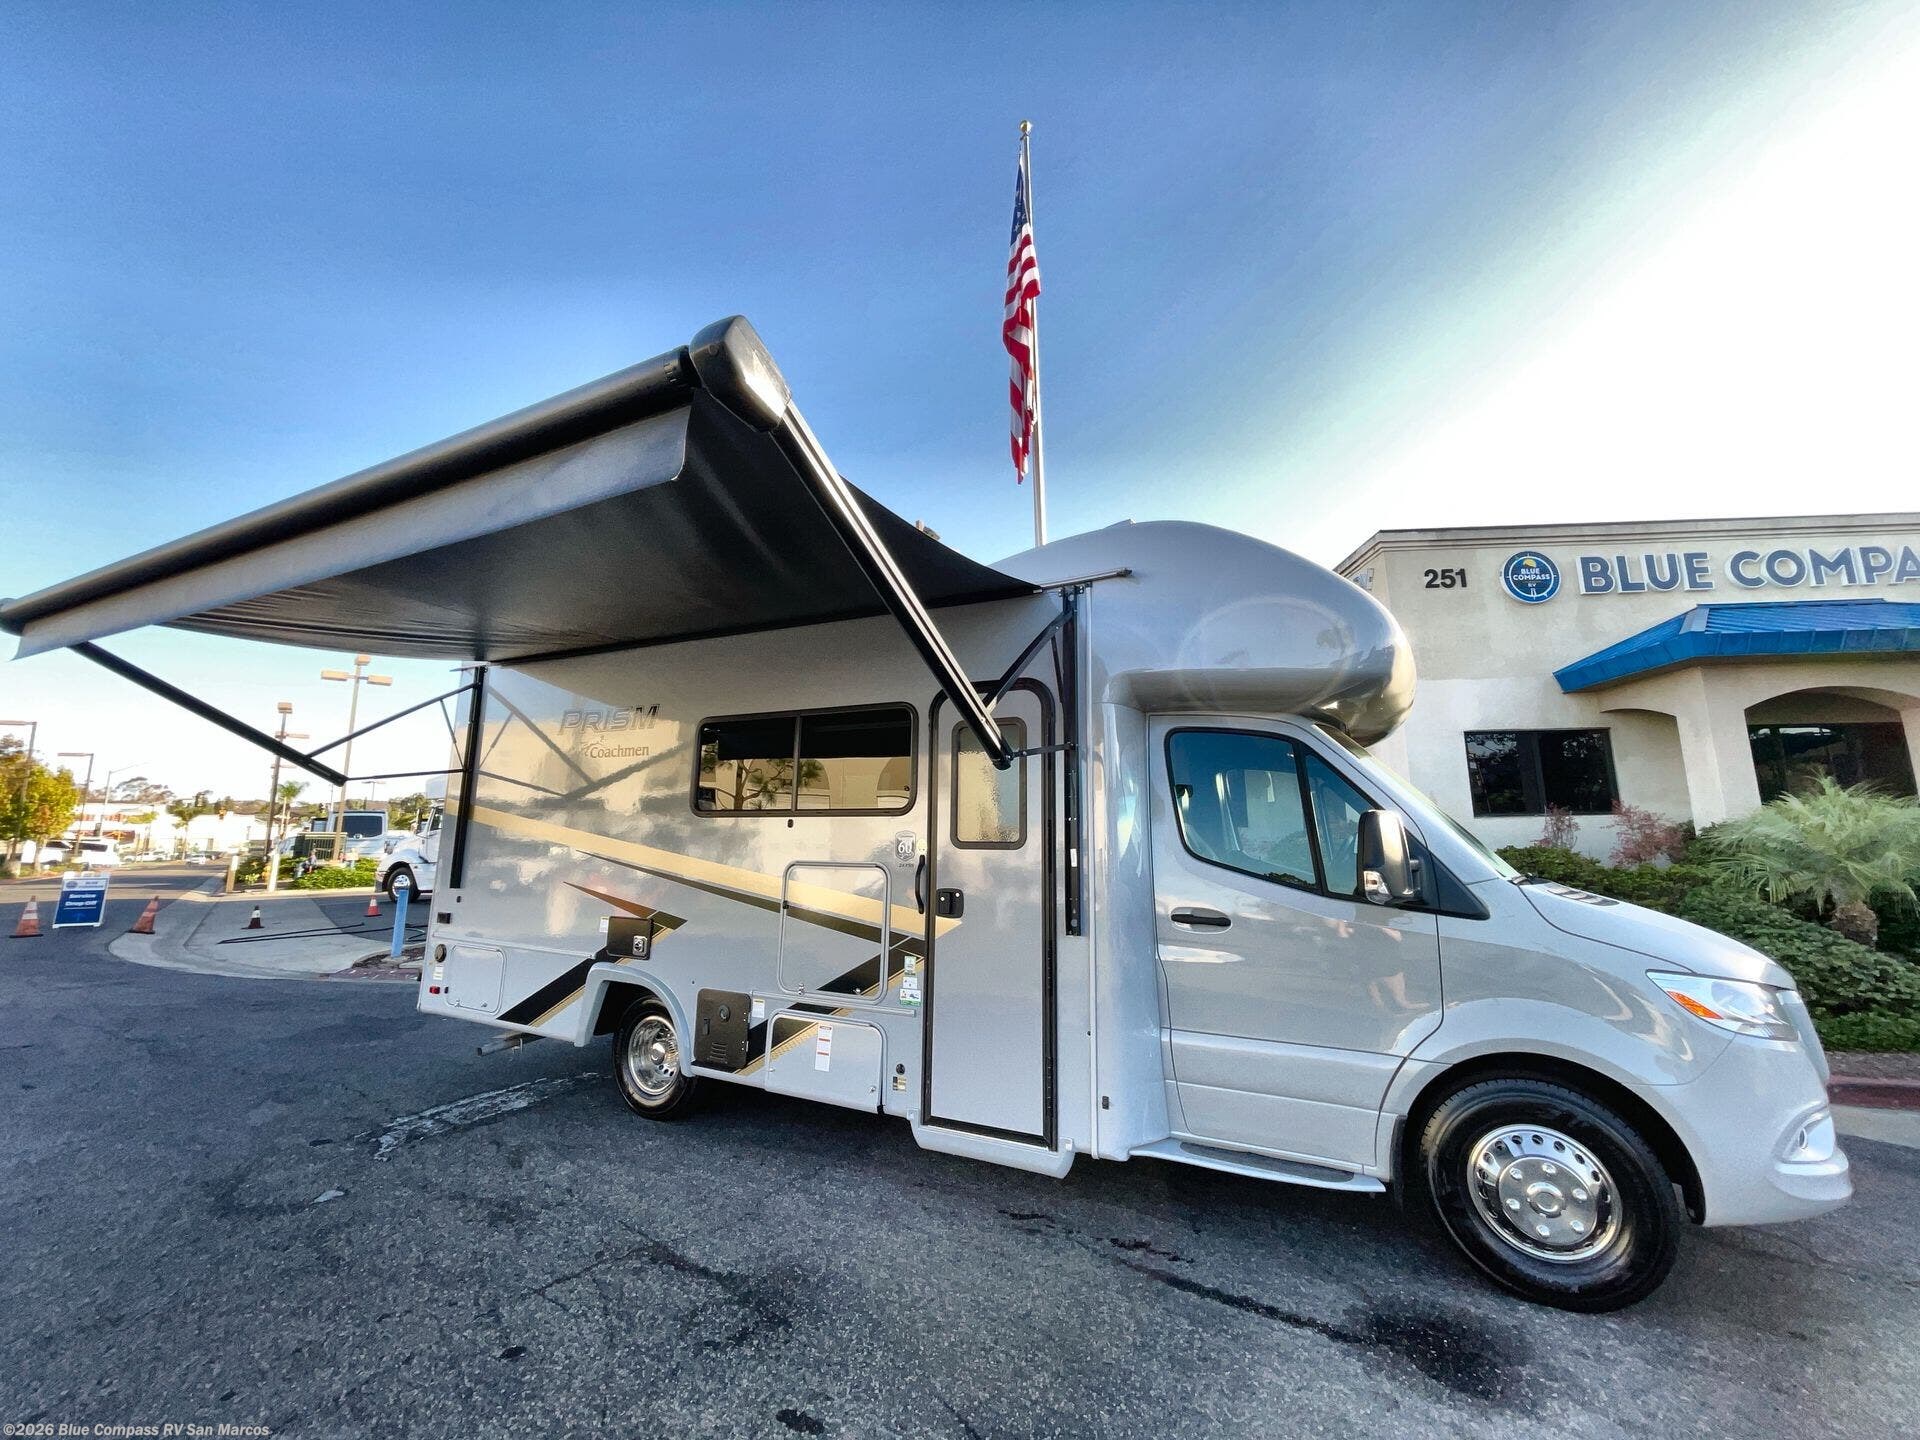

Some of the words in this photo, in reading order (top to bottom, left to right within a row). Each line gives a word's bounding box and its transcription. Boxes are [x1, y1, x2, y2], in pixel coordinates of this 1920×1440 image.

[1424, 568, 1467, 588] 251
[1579, 552, 1713, 594] BLUE
[1727, 545, 1920, 589] COMPA
[558, 704, 660, 735] PRISM
[589, 744, 649, 759] Coachmen
